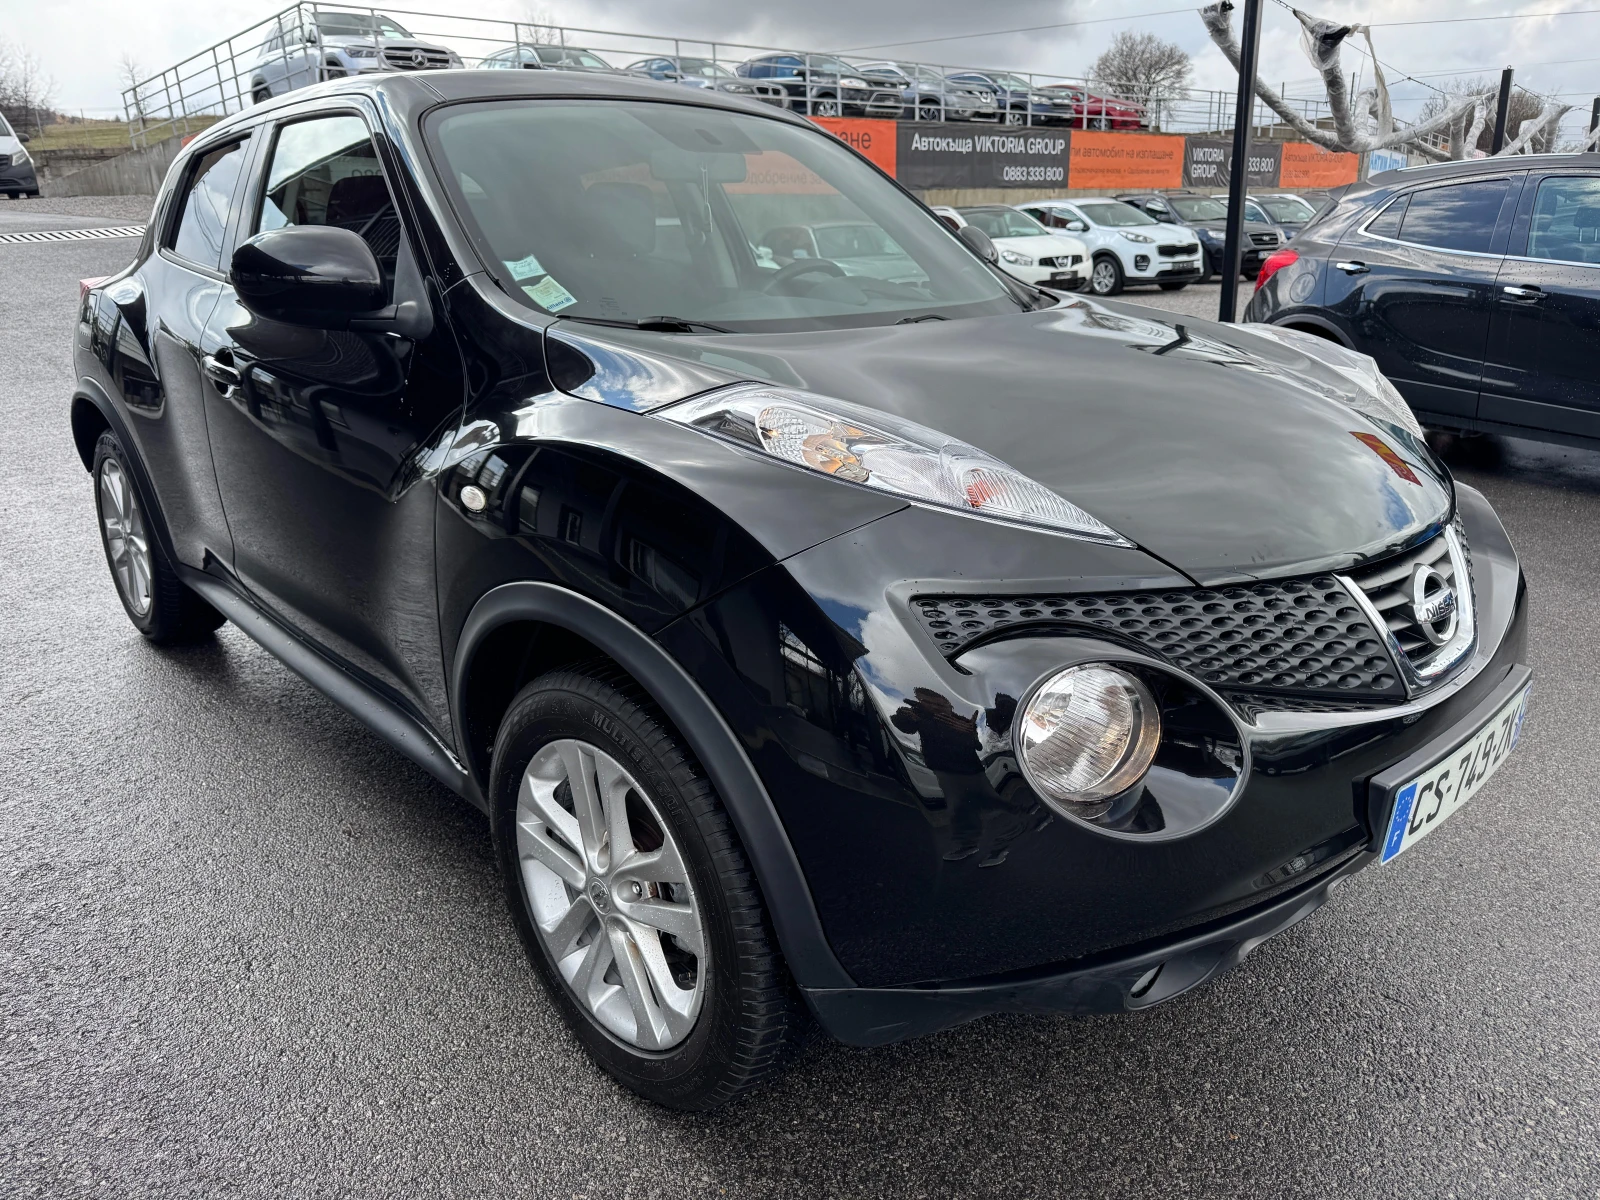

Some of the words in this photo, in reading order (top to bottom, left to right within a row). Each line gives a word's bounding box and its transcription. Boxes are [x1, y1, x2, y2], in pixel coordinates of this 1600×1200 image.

[835, 131, 872, 150] ане
[911, 132, 972, 153] Автокъща
[974, 135, 1026, 154] VIKTORIA
[1027, 138, 1065, 155] GROUP
[1192, 147, 1225, 162] VIKTORIA
[1191, 164, 1217, 178] GROUP
[1248, 157, 1260, 172] 333
[1003, 166, 1027, 181] 0883
[1027, 167, 1045, 181] 333
[1046, 167, 1063, 181] 800
[546, 300, 564, 311] Allianz
[1391, 830, 1400, 848] F
